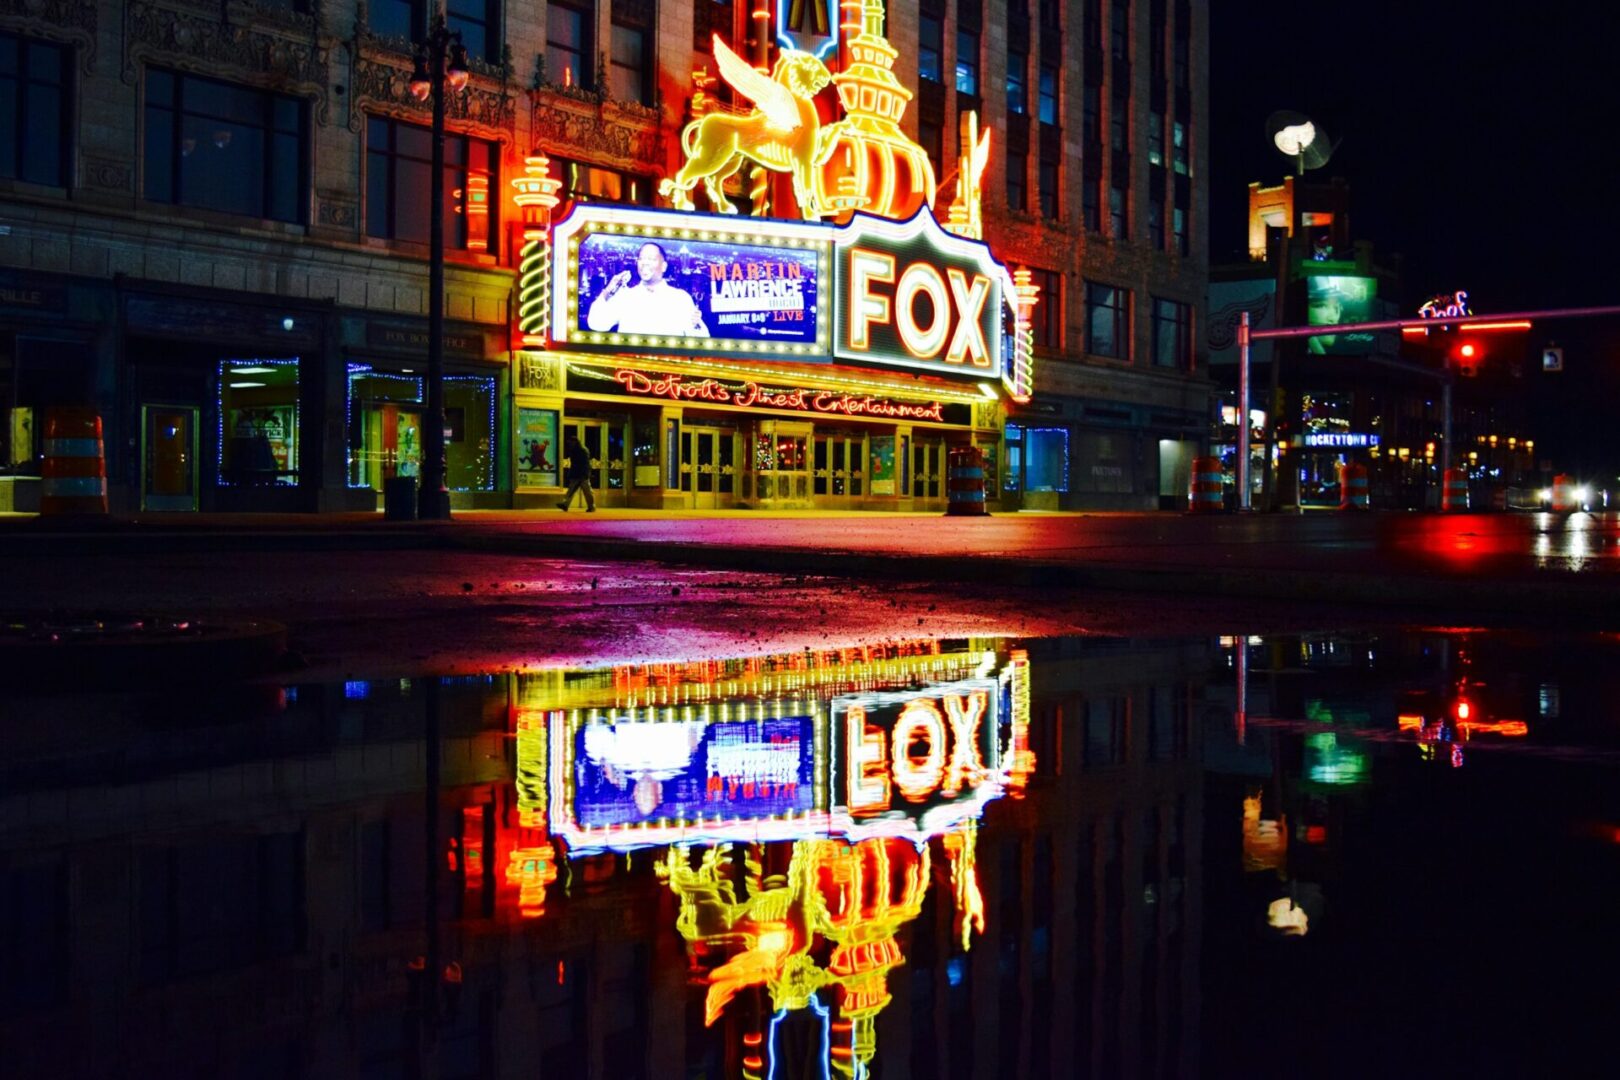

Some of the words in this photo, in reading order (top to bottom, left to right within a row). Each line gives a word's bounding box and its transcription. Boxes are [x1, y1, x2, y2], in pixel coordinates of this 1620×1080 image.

[710, 262, 801, 280] MARTIN
[710, 280, 803, 298] LAWRENCE
[850, 249, 991, 367] FOX
[718, 313, 751, 325] JANUARY
[773, 311, 804, 322] LIVE
[529, 366, 551, 379] FOX
[616, 370, 730, 401] Detroit's
[735, 381, 808, 407] Finest
[814, 391, 944, 422] Entertainment
[1305, 434, 1367, 446] HOCKEYTOWN
